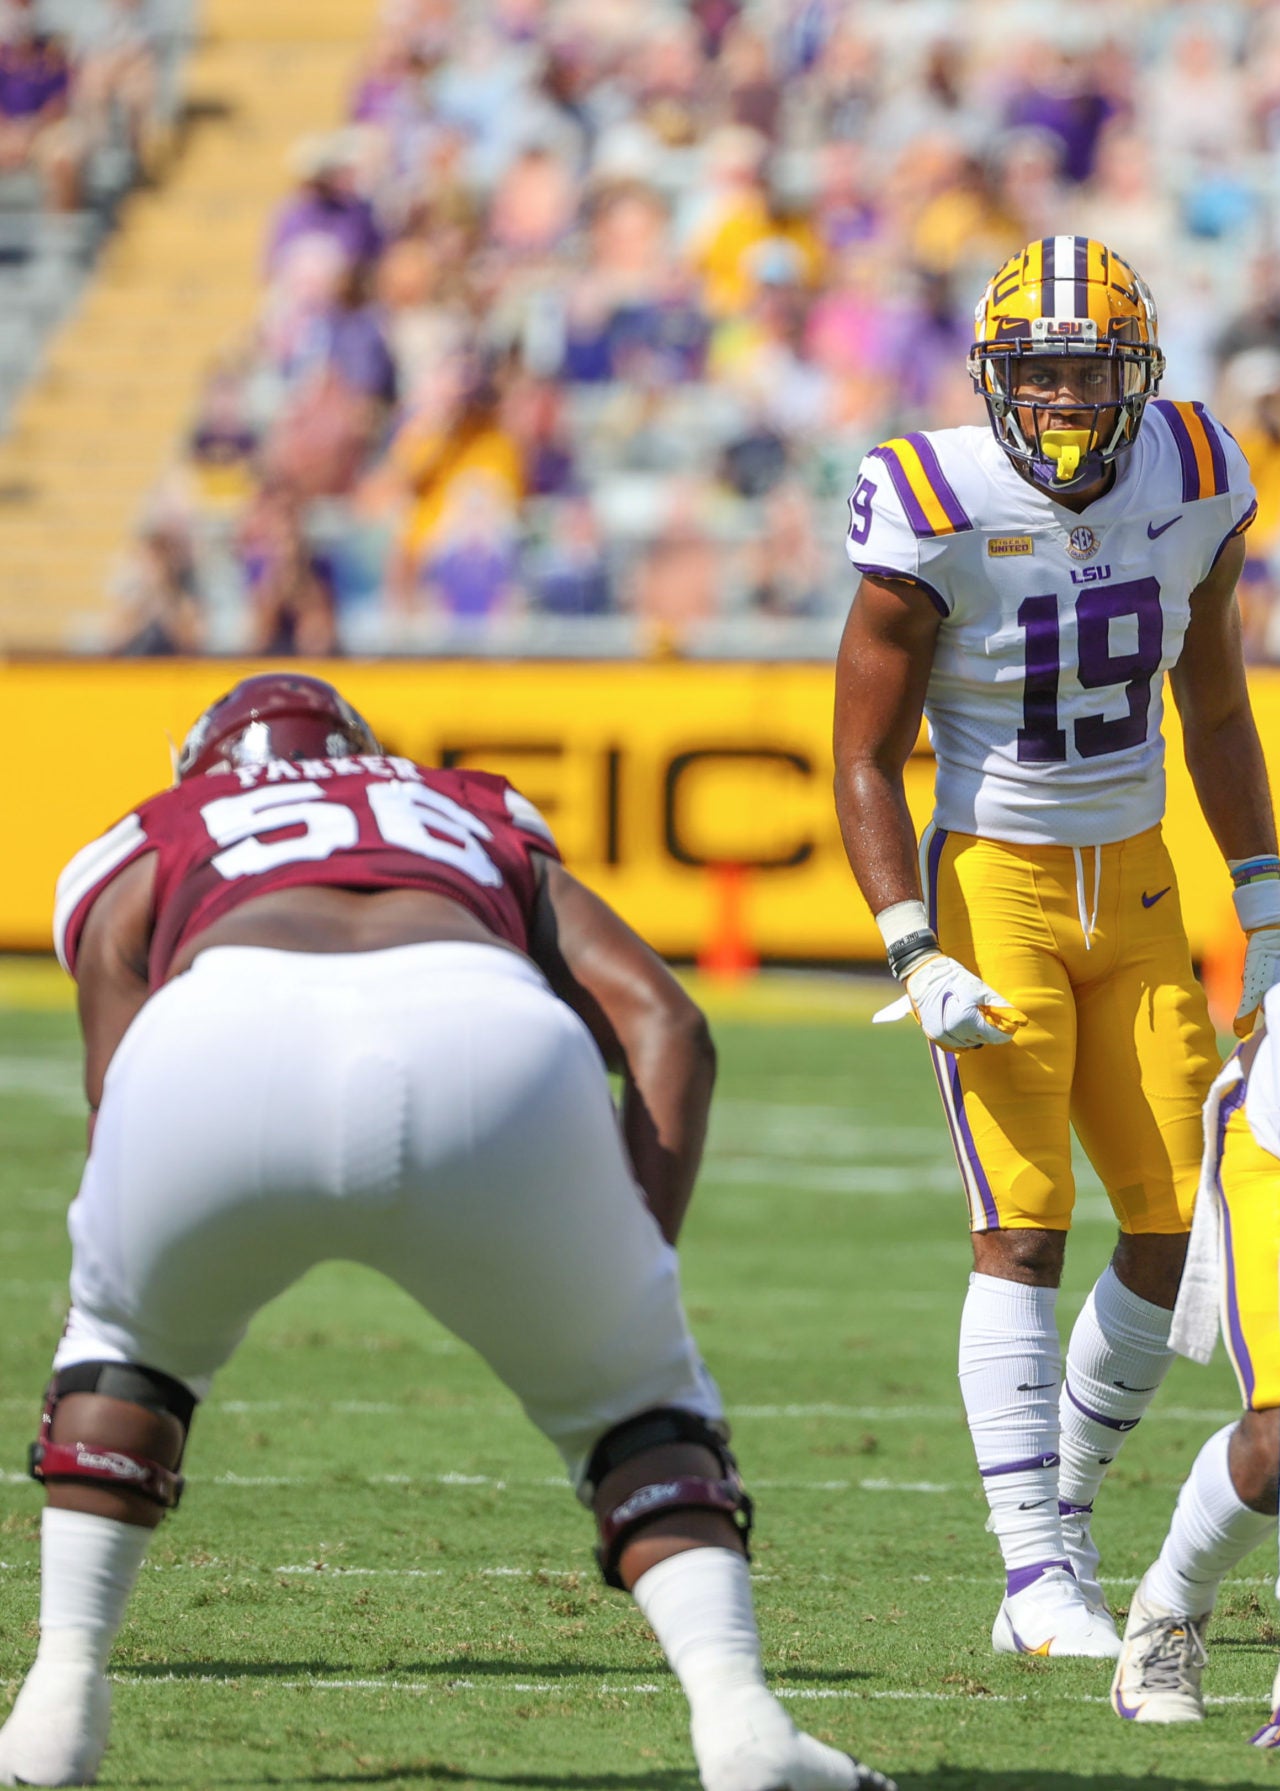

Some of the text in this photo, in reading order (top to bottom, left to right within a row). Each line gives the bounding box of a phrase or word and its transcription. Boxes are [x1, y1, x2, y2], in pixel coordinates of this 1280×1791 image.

[1047, 321, 1083, 335] LSU
[847, 473, 878, 546] 9
[990, 544, 1029, 553] UNITED
[1070, 526, 1094, 551] SEC
[1069, 564, 1112, 585] LSU
[1016, 575, 1164, 763] 19
[233, 754, 424, 788] PARKER
[199, 778, 504, 889] 56
